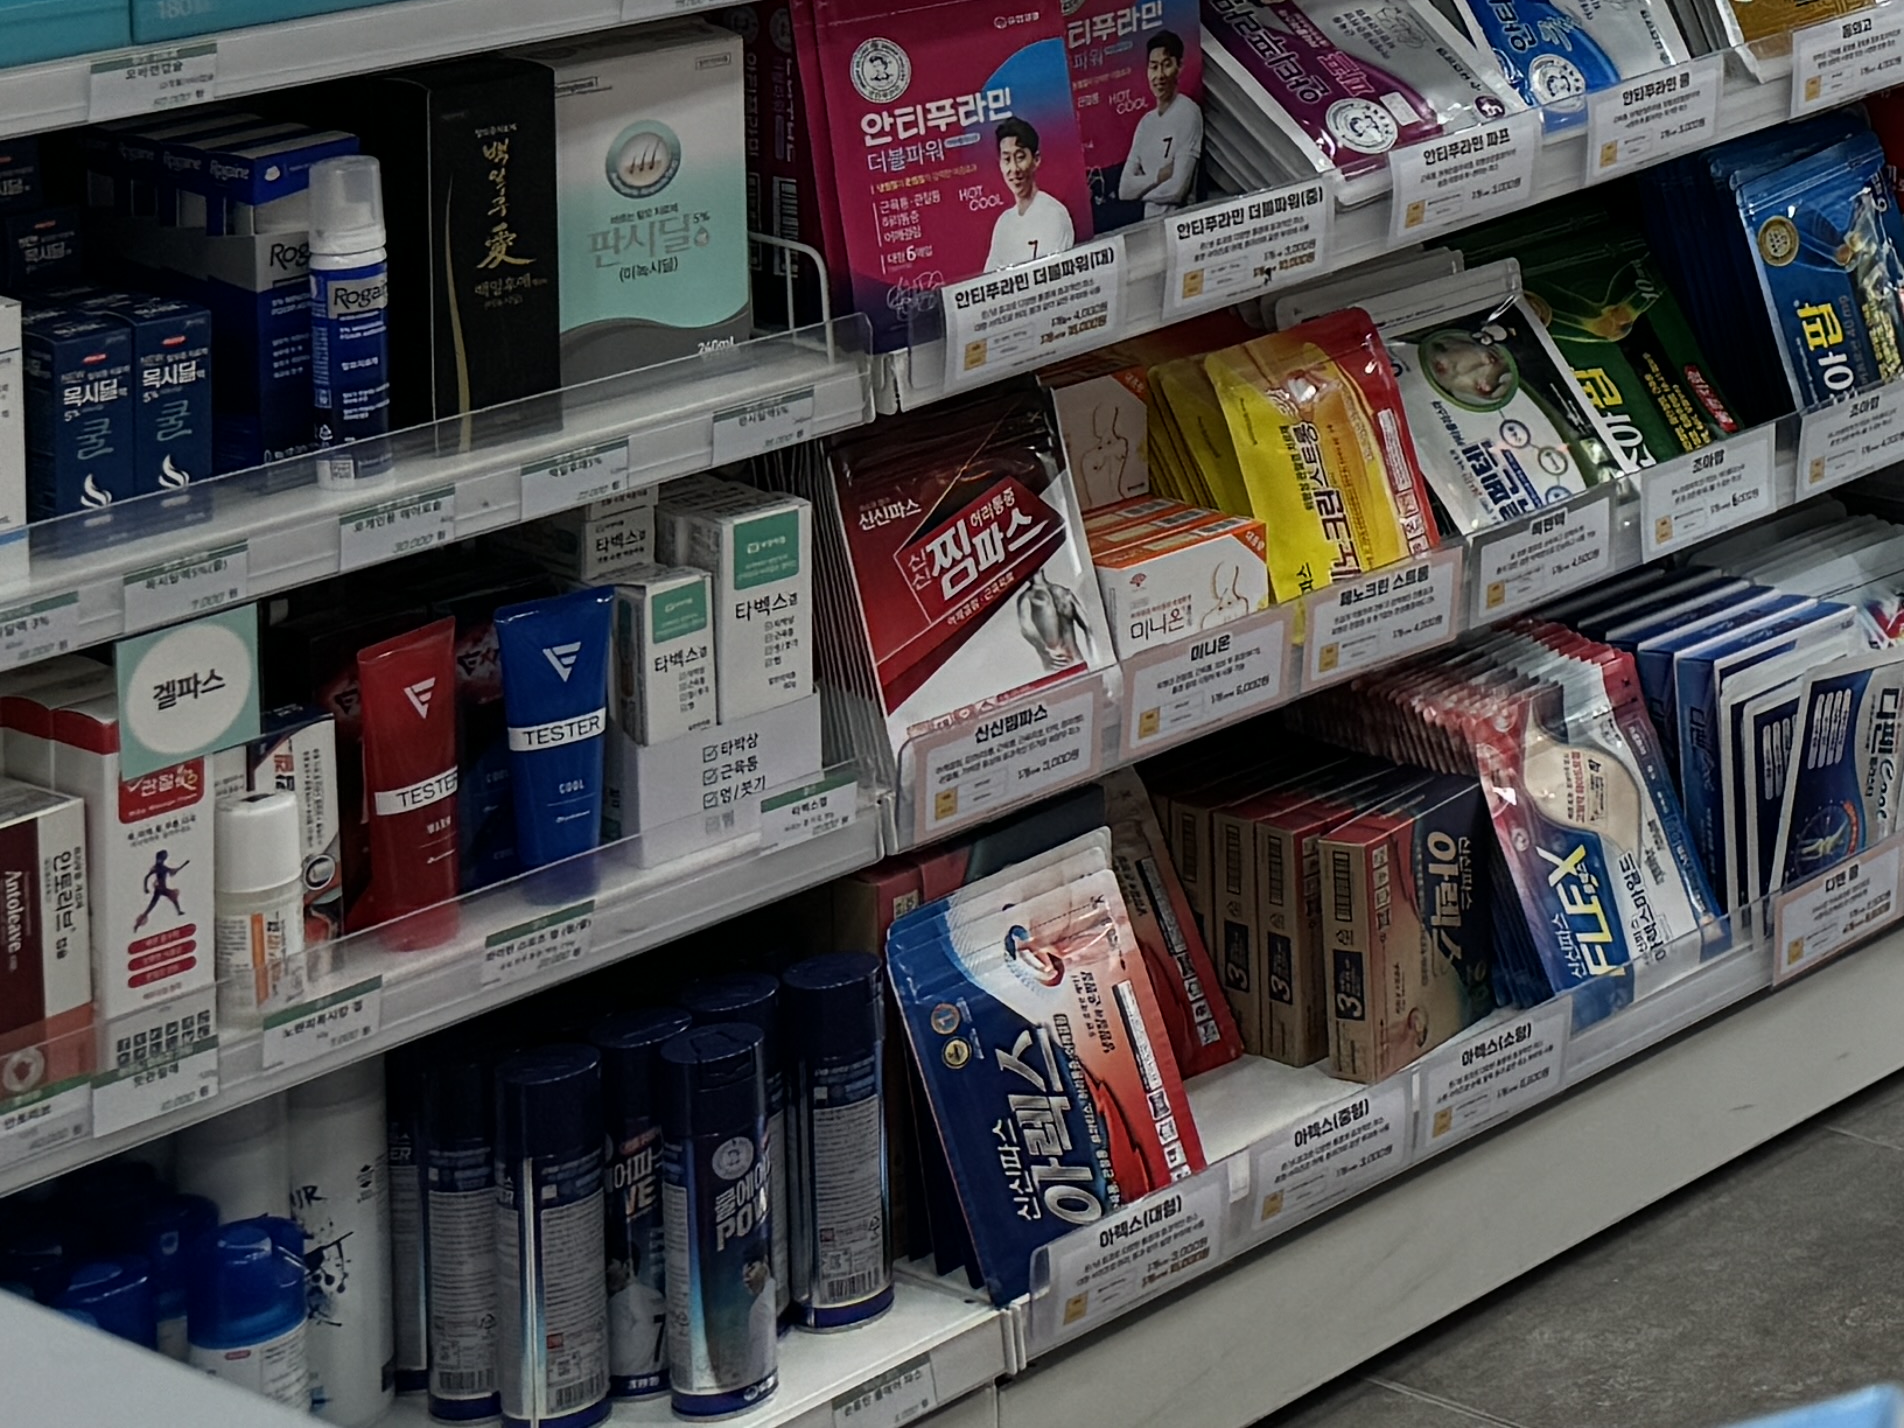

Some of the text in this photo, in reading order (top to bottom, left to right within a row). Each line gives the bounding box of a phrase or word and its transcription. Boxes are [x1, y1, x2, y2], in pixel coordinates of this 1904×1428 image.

[861, 91, 1013, 146] 안티푸라민
[868, 137, 945, 173] 더블파워
[959, 187, 984, 205] HOT
[969, 194, 1004, 212] COOL
[1176, 211, 1246, 240] 안티푸라민
[618, 255, 680, 282] (미녹시딜)
[955, 247, 1115, 310] 안티푸라민 더블파워(대)
[142, 362, 197, 390] 목시딜
[859, 500, 922, 530] 신신파스
[930, 508, 1049, 600] 찜파스
[1130, 612, 1184, 643] 미니온
[1190, 634, 1231, 662] 미니온
[153, 673, 226, 712] 겔파스
[523, 715, 601, 746] TESTER
[720, 733, 760, 756] 타박상
[720, 756, 759, 780] 근육통
[399, 768, 459, 809] TESTER
[1537, 844, 1625, 977] FLEX
[995, 1025, 1102, 1226] 아렉스
[1294, 1098, 1370, 1148] 아렉스(중형)
[1099, 1196, 1182, 1247] 아렉스(대형)
